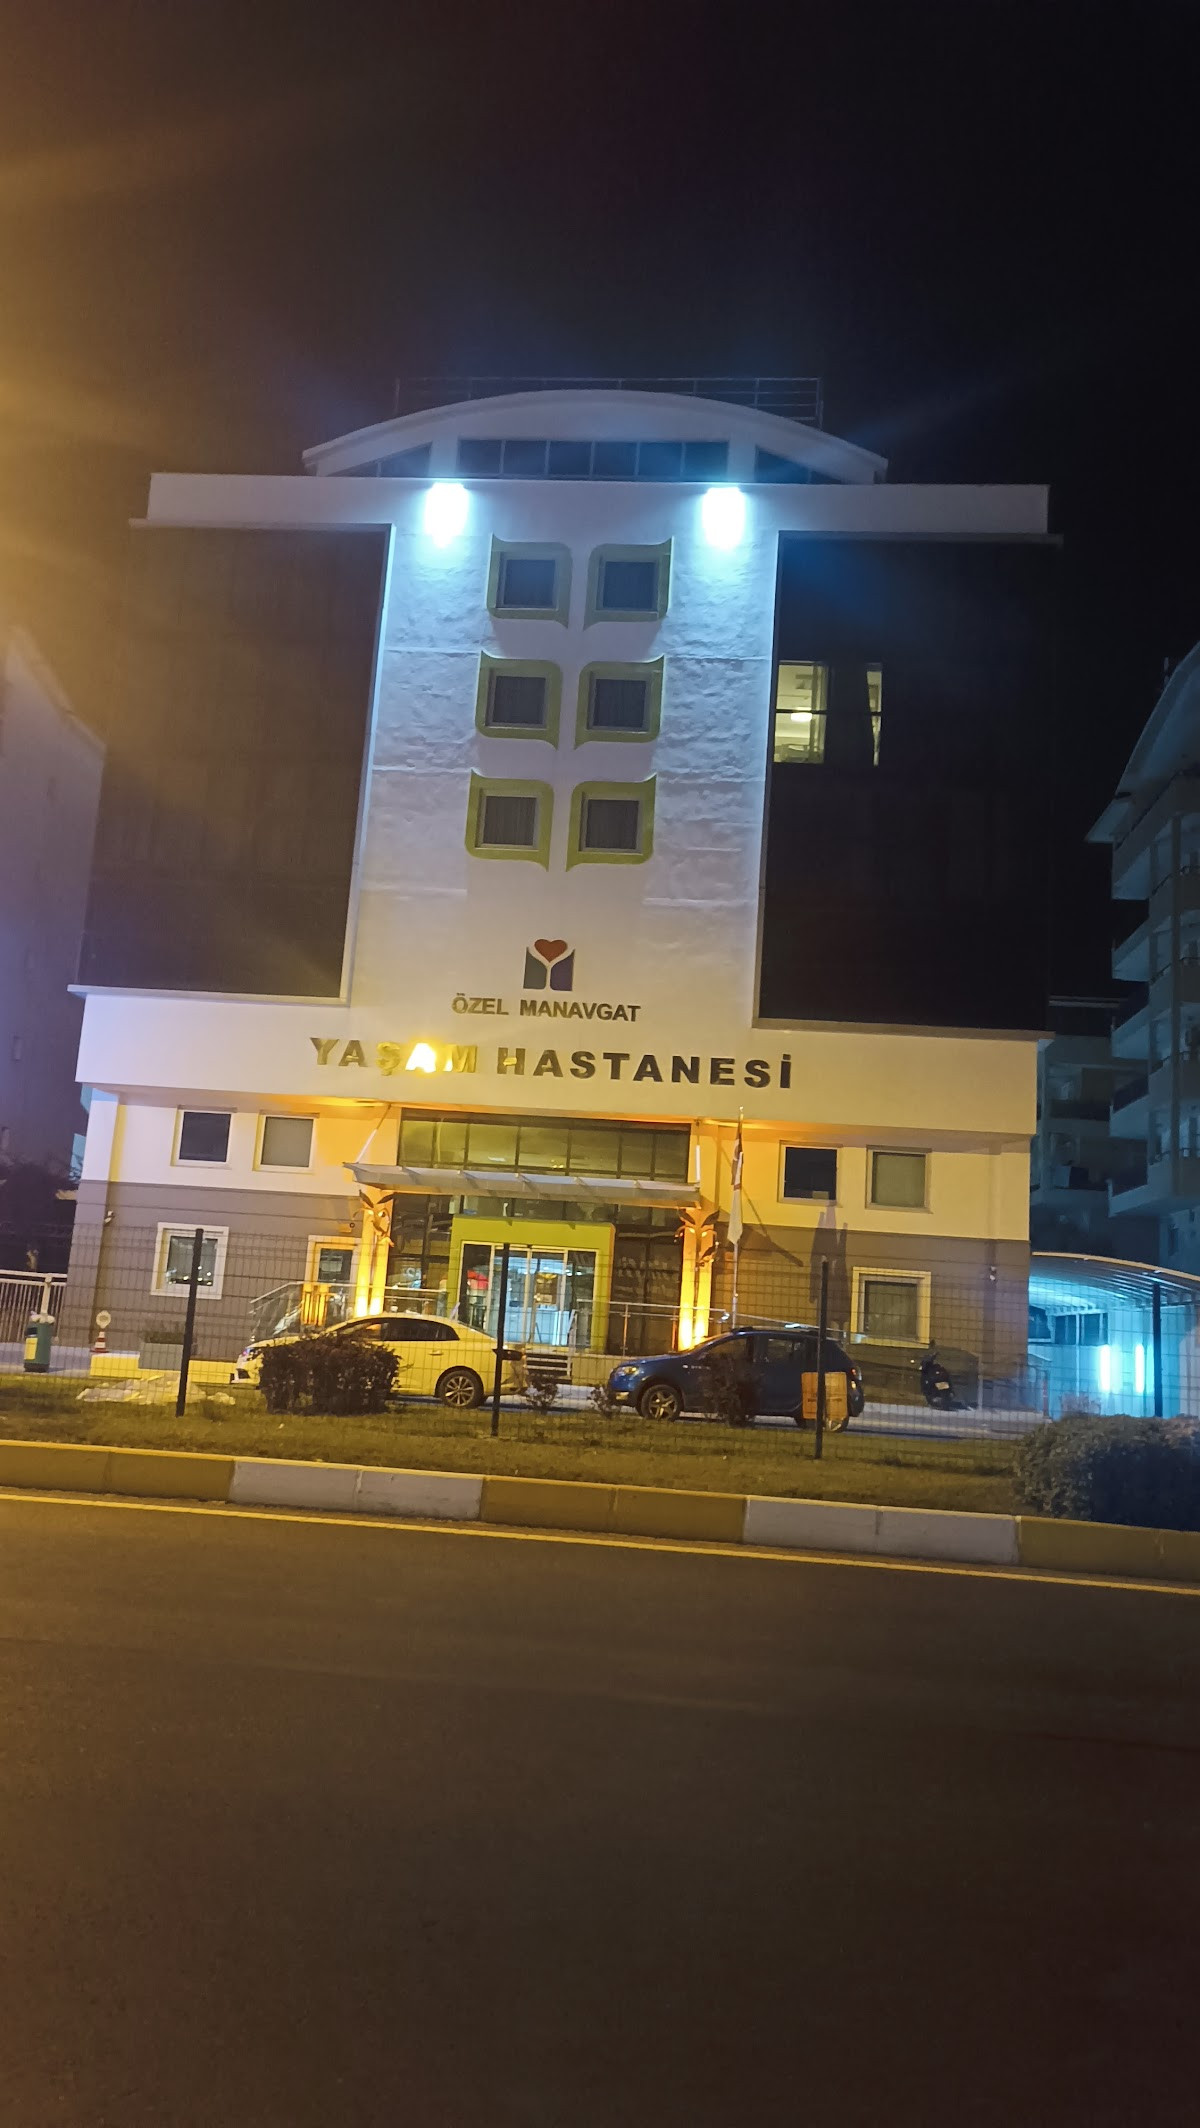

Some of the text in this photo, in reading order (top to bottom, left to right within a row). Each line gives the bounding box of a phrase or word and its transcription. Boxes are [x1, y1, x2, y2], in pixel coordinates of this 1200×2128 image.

[452, 992, 642, 1022] ÖZEL MANAVGAT
[309, 1037, 792, 1089] YAŞAM HASTANESİ
